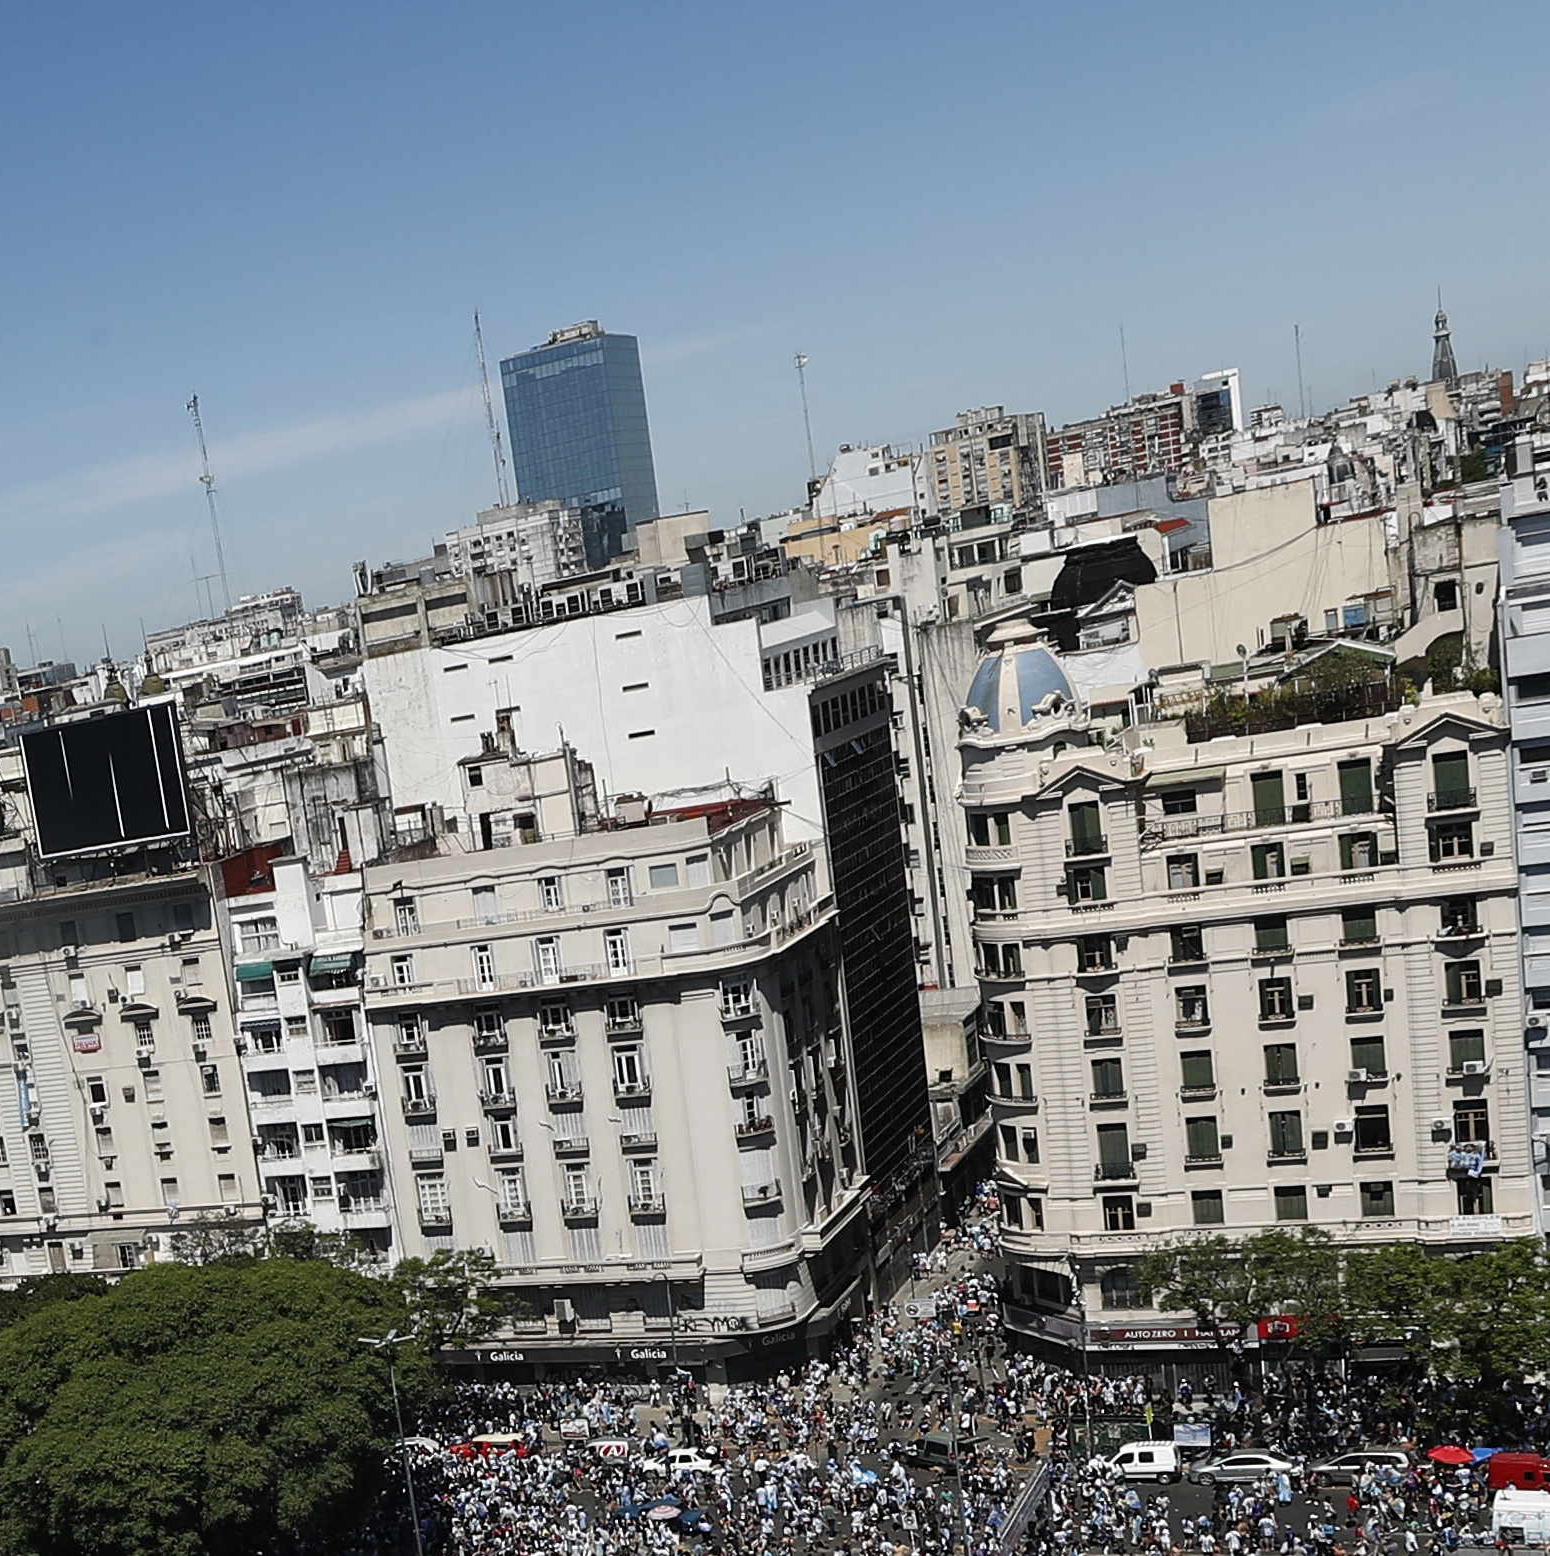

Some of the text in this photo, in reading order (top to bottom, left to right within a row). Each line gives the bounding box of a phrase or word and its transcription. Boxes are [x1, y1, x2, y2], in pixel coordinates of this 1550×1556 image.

[762, 1330, 796, 1347] Galicia
[489, 1350, 524, 1362] Galicia
[630, 1348, 667, 1360] Galicia
